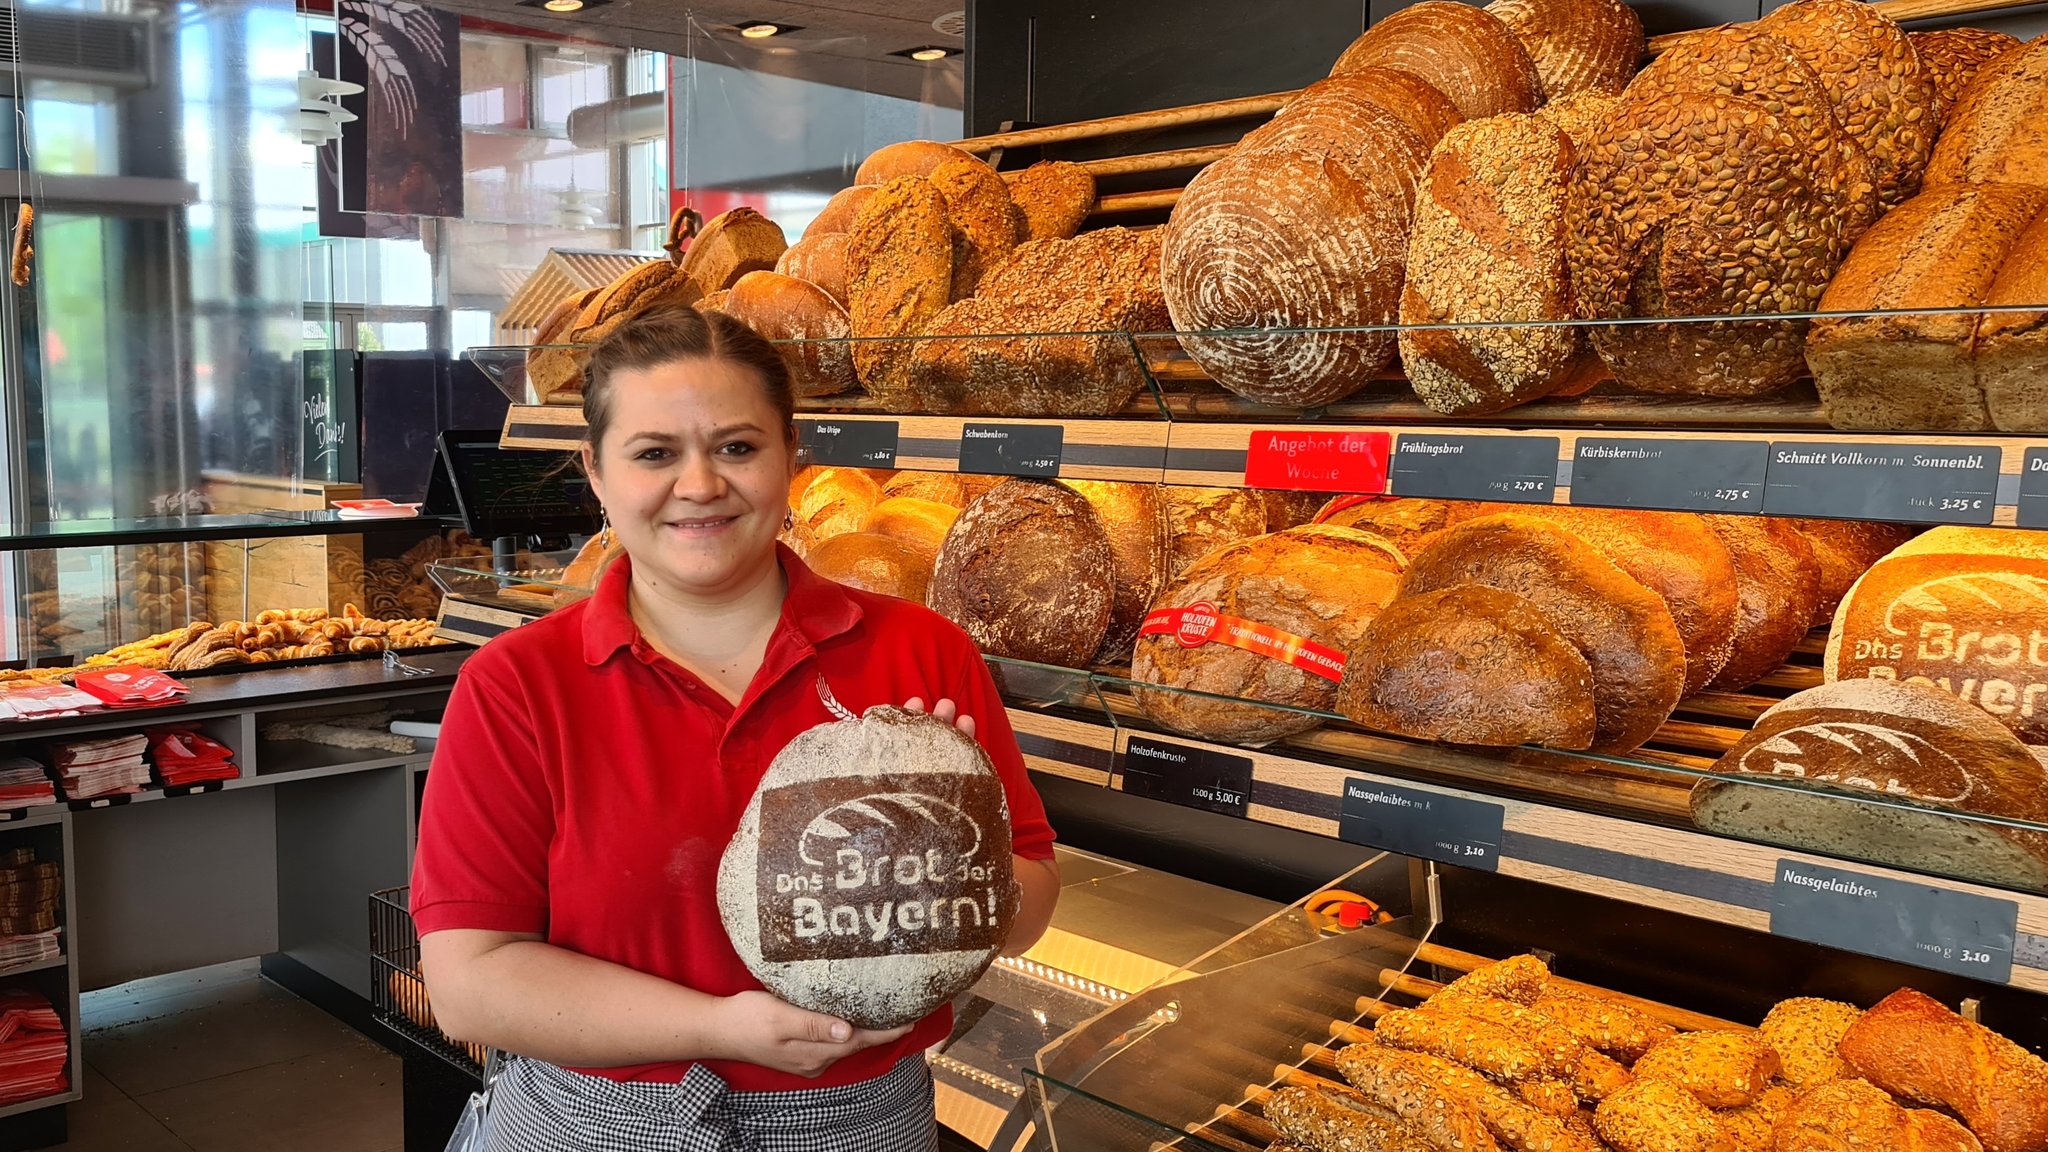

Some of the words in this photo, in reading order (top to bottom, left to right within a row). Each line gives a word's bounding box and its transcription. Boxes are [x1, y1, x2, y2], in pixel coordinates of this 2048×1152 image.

[964, 429, 1009, 440] Schwabenkorn
[1267, 435, 1335, 458] Angebot
[1339, 435, 1368, 453] der
[1400, 441, 1464, 457] Frühlingsbrot
[1579, 446, 1663, 459] Kürbiskernbrot
[1776, 451, 1828, 465] Schmitt
[1831, 452, 1888, 467] Vollkorn
[1911, 454, 1985, 470] Sonnenbl.
[1514, 481, 1535, 492] 2,70
[1536, 482, 1544, 490] €
[1714, 489, 1739, 501] 2,75
[1741, 490, 1750, 499] €
[1939, 496, 1969, 511] 3,25
[1972, 499, 1982, 509] €
[1181, 612, 1218, 628] HOLZOFEN
[1181, 623, 1210, 637] KRUSTE
[1274, 639, 1284, 650] IM
[1916, 620, 2048, 668] Brot
[1130, 744, 1187, 764] Holzofenkruste
[1192, 787, 1209, 798] 1500
[1208, 792, 1214, 801] g
[1215, 791, 1234, 804] 5,00
[1234, 795, 1241, 805] €
[1348, 785, 1412, 808] Nassgelaibtes
[1453, 844, 1460, 854] g
[835, 849, 945, 890] Brot
[1783, 869, 1879, 899] Nassgelaibtes
[792, 887, 998, 943] Bayern!
[1943, 946, 1952, 959] g
